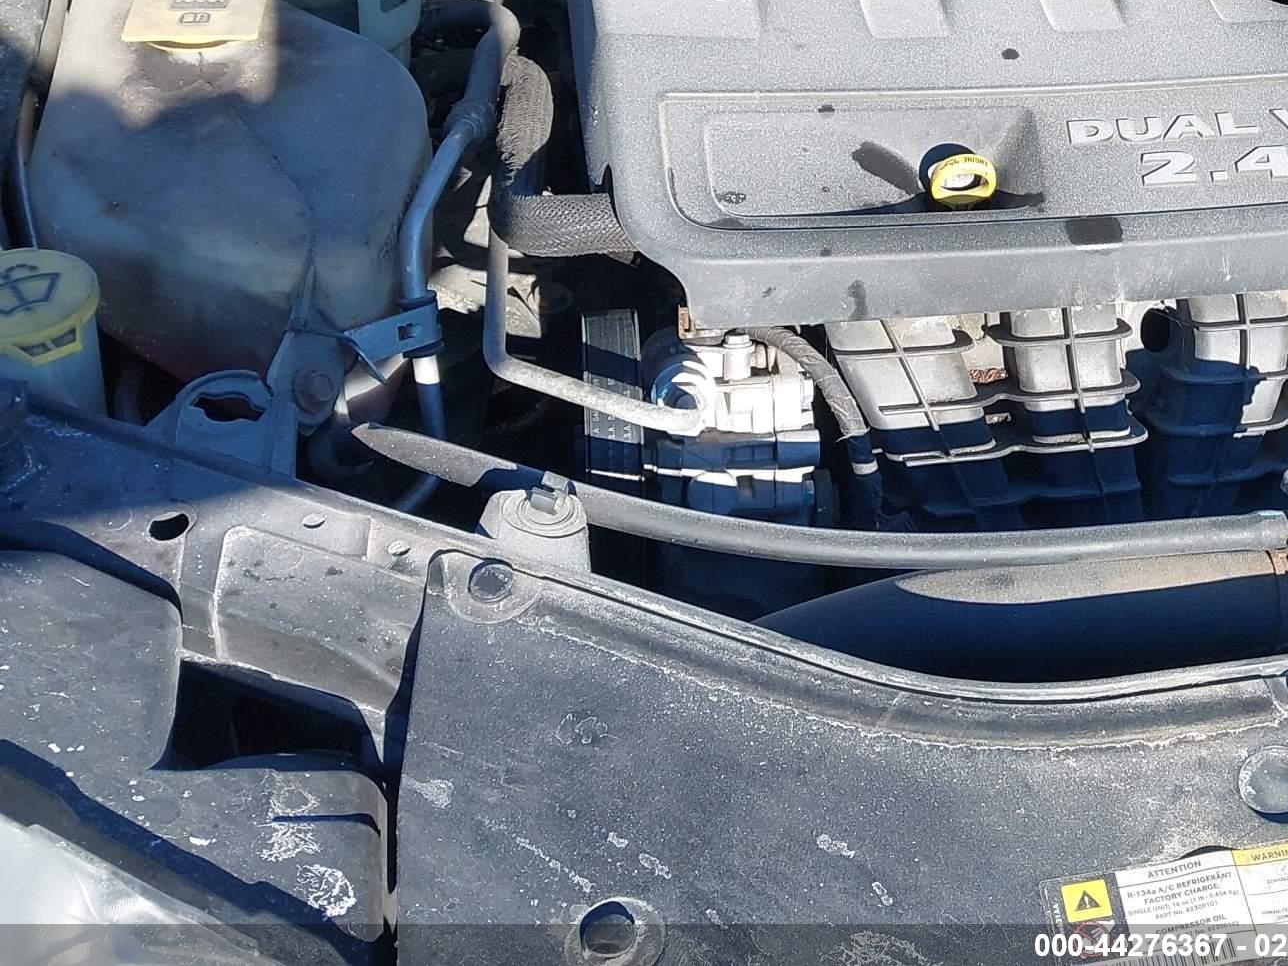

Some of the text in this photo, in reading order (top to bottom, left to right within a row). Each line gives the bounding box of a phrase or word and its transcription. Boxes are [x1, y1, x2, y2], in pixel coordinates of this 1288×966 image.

[1066, 112, 1261, 146] DUAL
[1147, 859, 1202, 879] ATTENTION
[1127, 872, 1233, 899] R-134a A/C REFRIGERANT
[1144, 883, 1221, 905] FACTORY CHARGE
[1155, 914, 1228, 935] COMPRESSOR OIL
